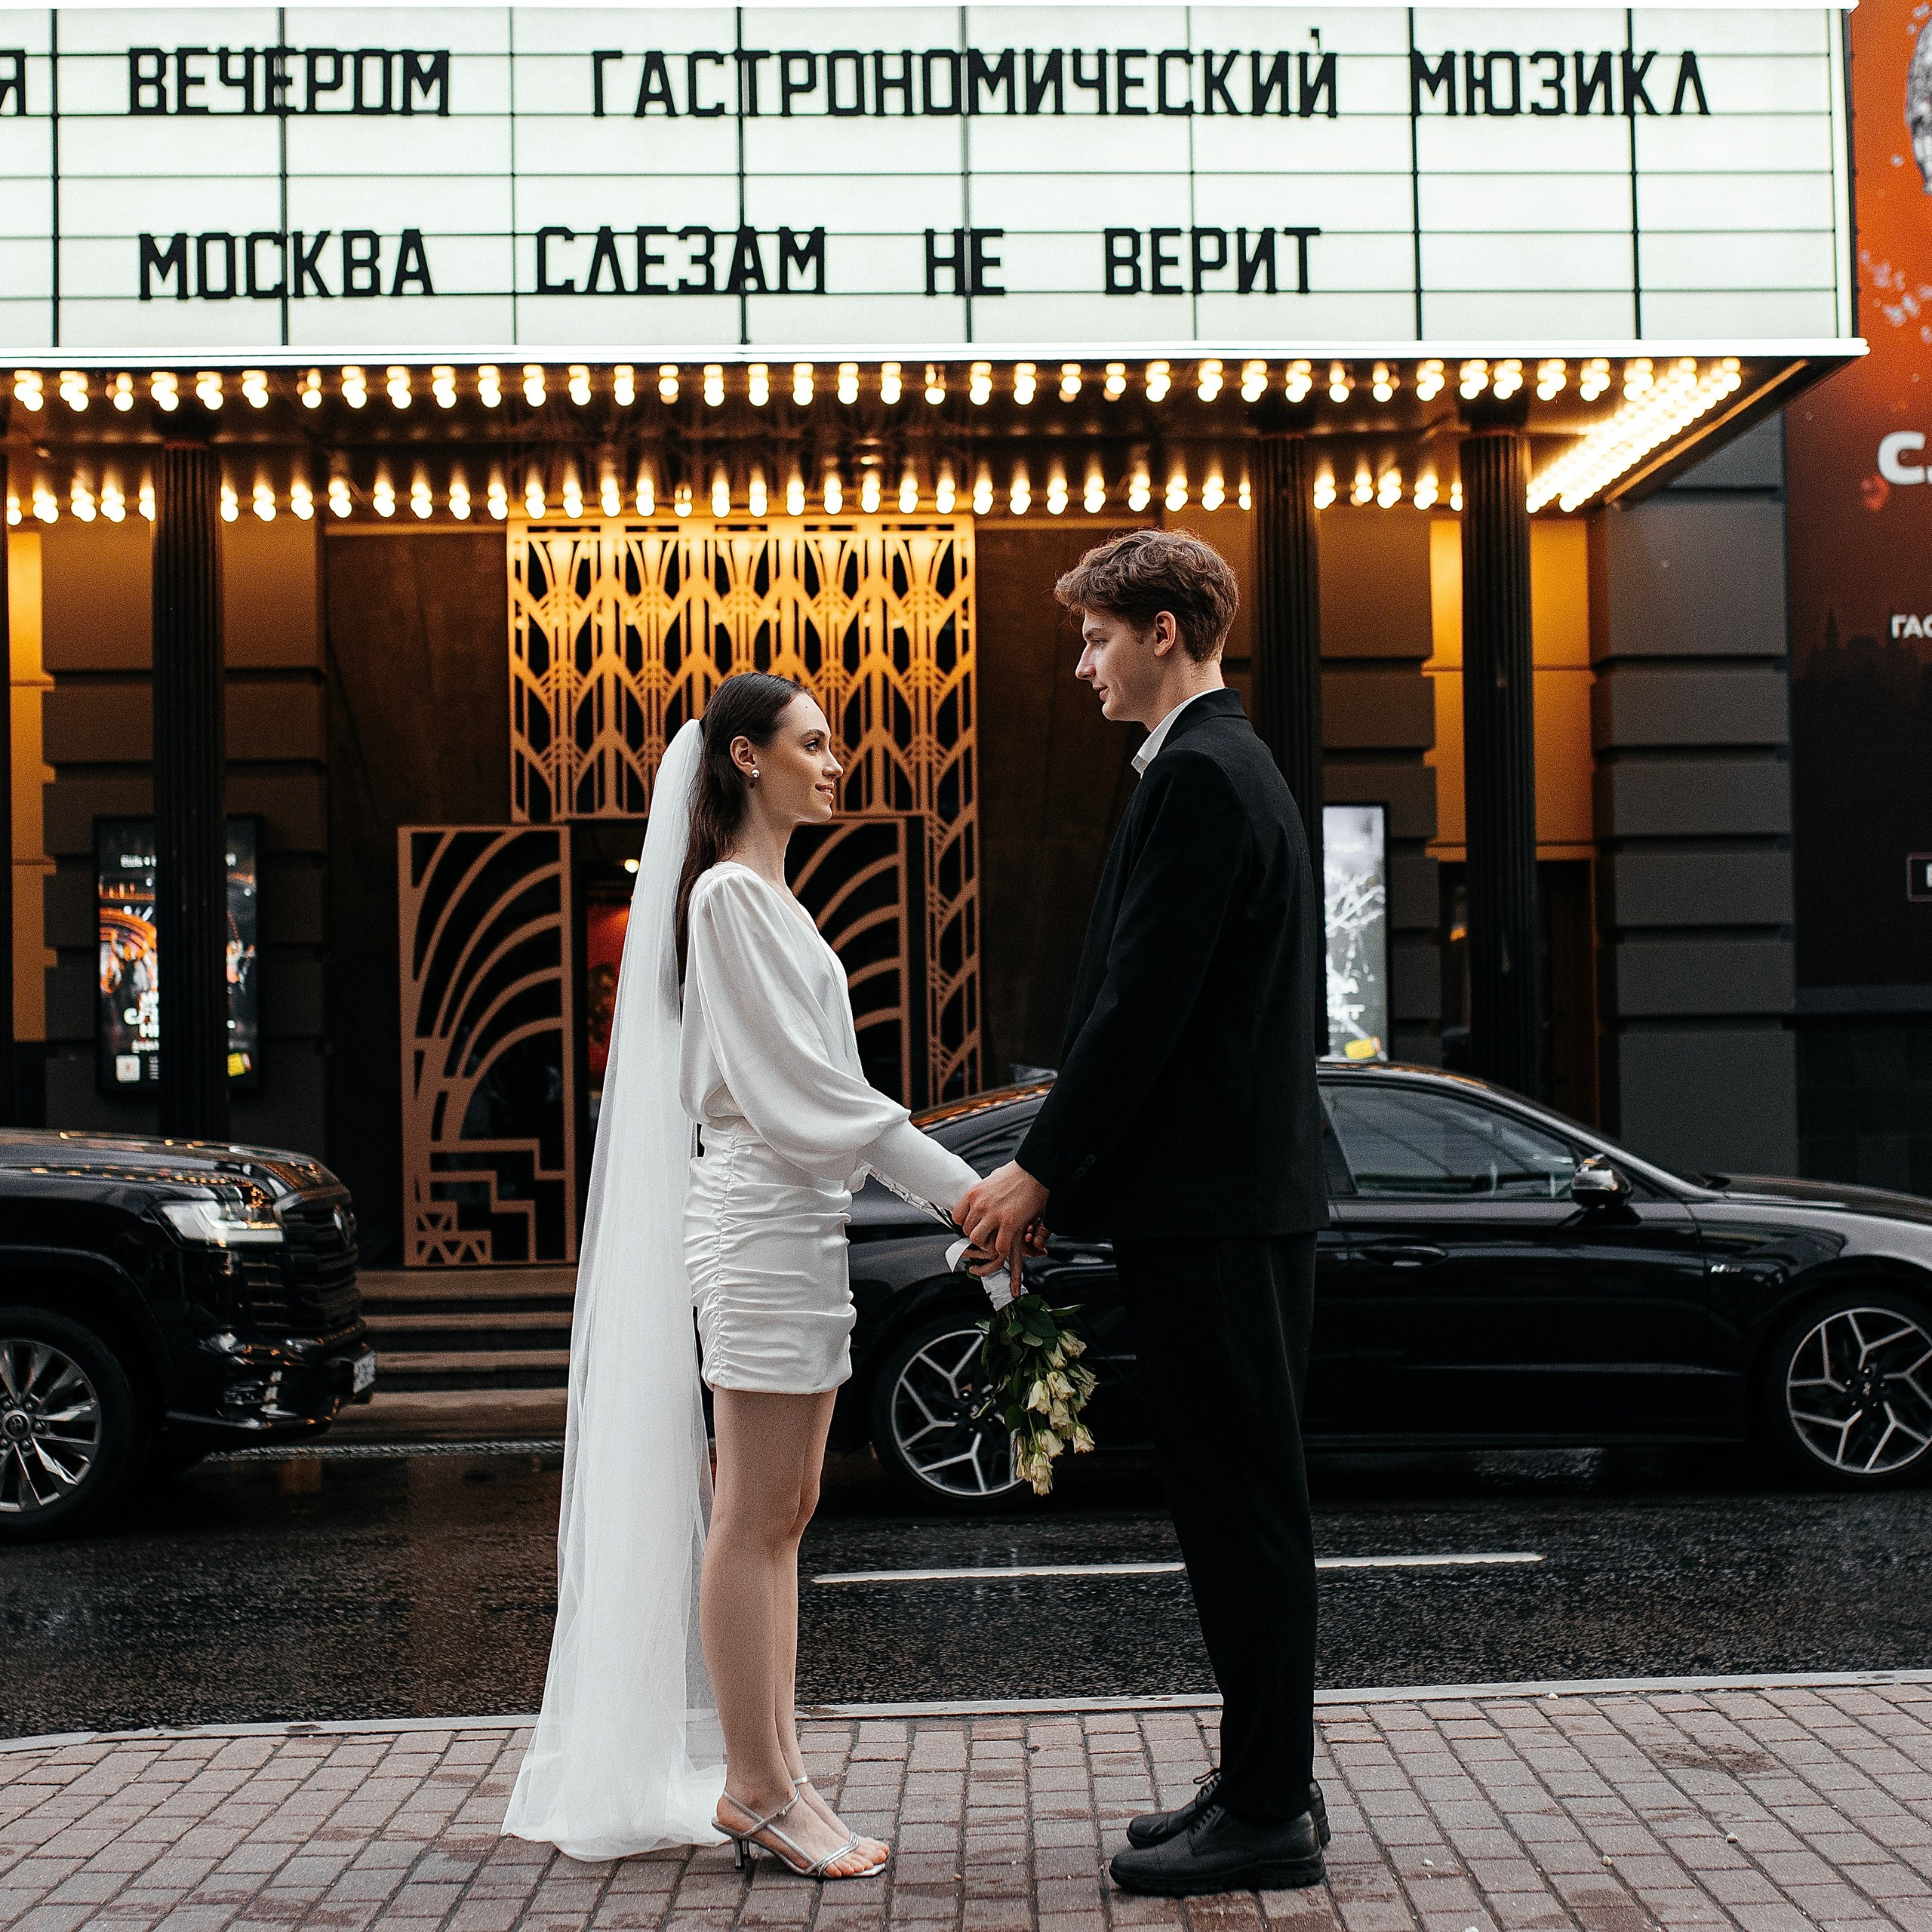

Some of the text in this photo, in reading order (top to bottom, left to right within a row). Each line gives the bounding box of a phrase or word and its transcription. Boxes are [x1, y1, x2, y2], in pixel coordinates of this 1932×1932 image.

[128, 47, 450, 117] ВЕЧЕРОМ
[592, 29, 1337, 118] ГАСТРОНОМИЧЕСКИЙ
[1410, 51, 1710, 116] МЮЗИКЛ
[139, 226, 1321, 301] МОСКВА СЛЕЗАМ НЕ ВЕРИТ
